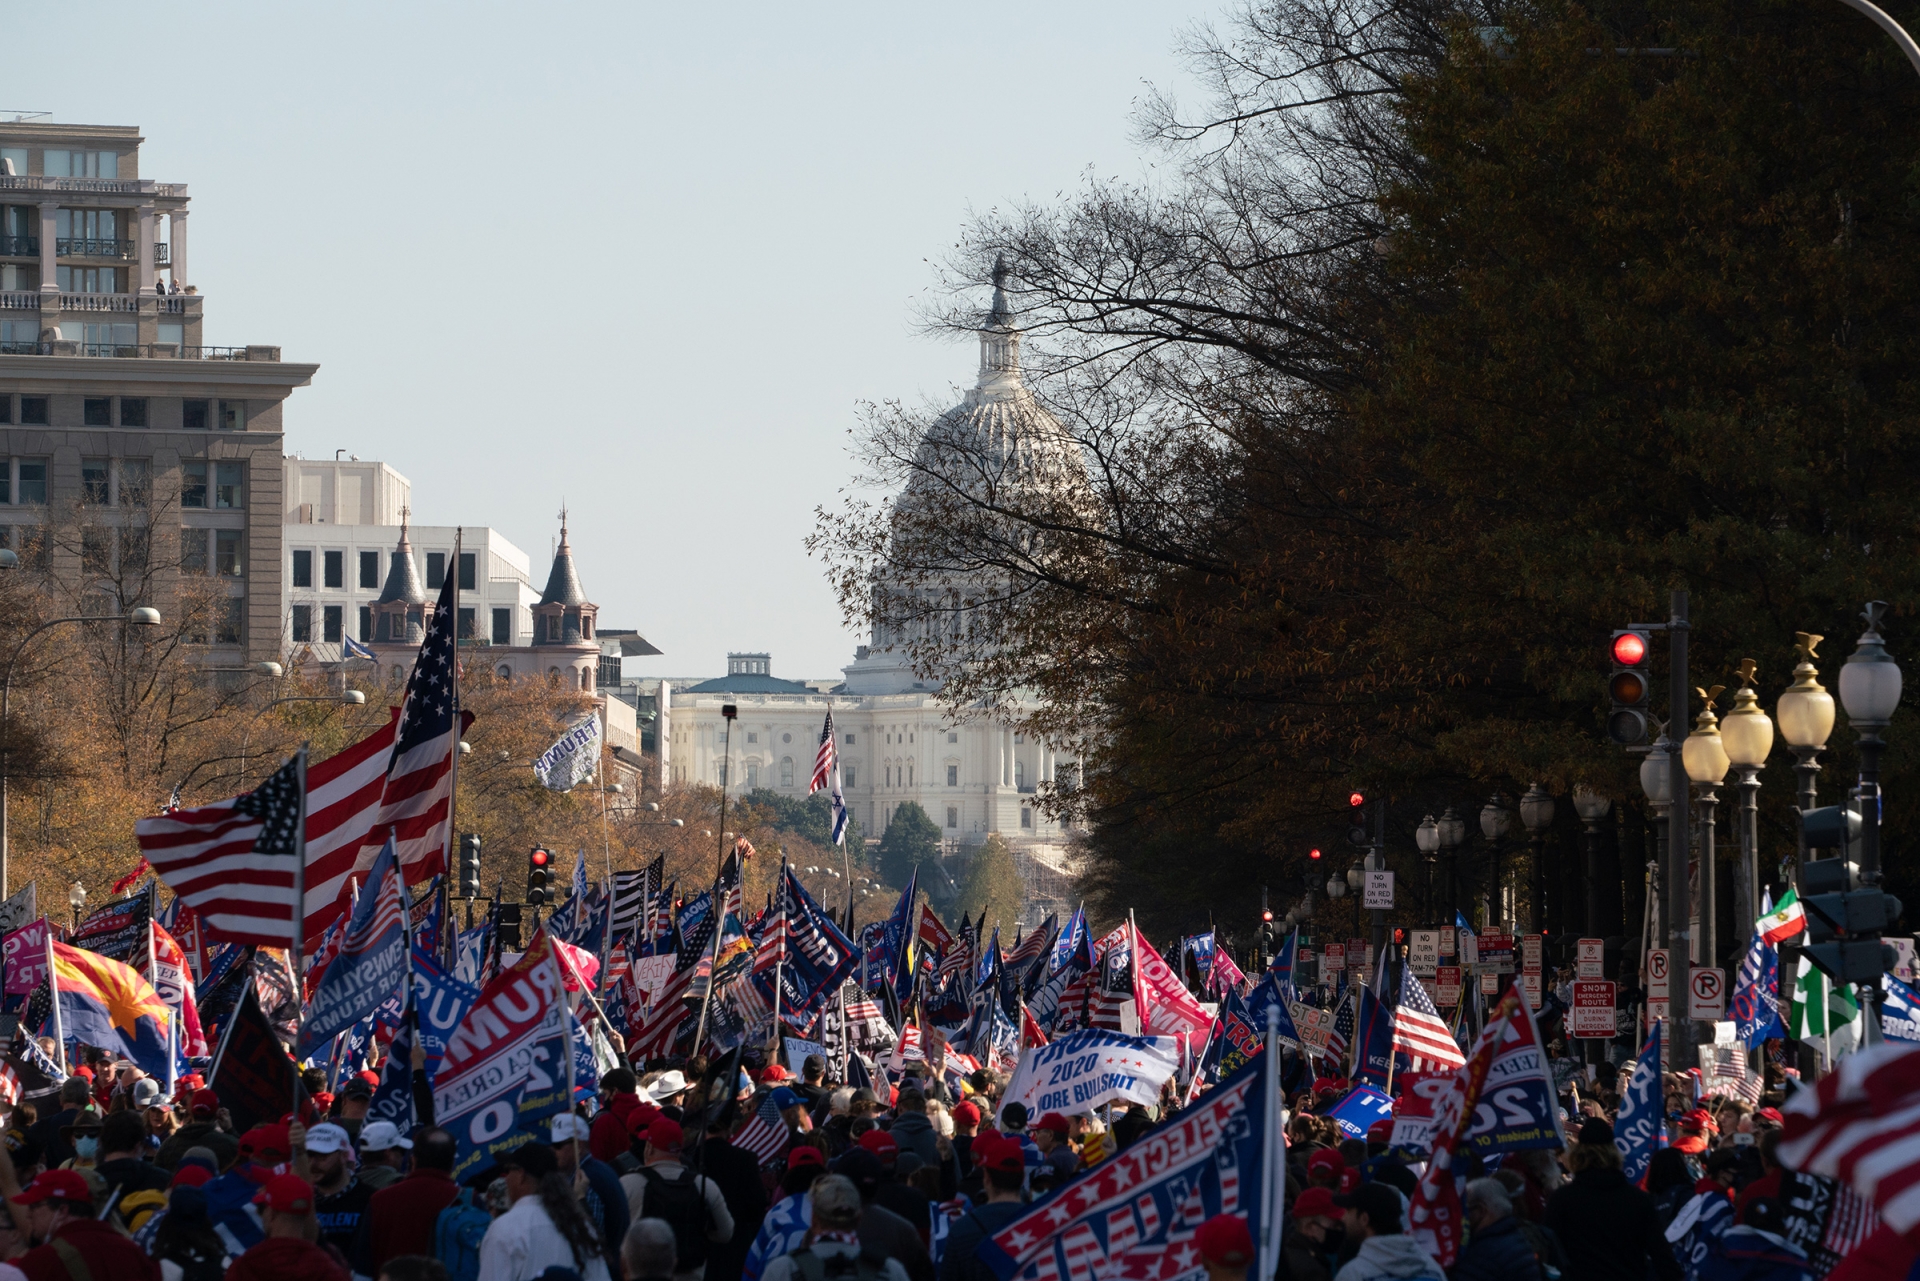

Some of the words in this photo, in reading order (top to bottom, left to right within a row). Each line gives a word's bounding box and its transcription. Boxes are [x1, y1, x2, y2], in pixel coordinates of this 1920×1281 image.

[1417, 944, 1433, 952] TURN
[1420, 934, 1430, 942] NO
[636, 956, 676, 981] VERIFY
[1413, 954, 1422, 962] ON
[1424, 954, 1436, 962] RED
[712, 994, 727, 1027] TRUMP
[1291, 1004, 1330, 1028] STOP
[1226, 1011, 1265, 1058] TRU
[1295, 1023, 1327, 1048] TEAL
[1882, 1014, 1920, 1042] ERIC
[787, 1039, 826, 1057] EVIDENCE
[1279, 1035, 1326, 1057] #StopeSteal
[1049, 1053, 1100, 1087] 2020
[1369, 1055, 1400, 1071] KEEP
[1074, 1072, 1137, 1102] BULLSHIT
